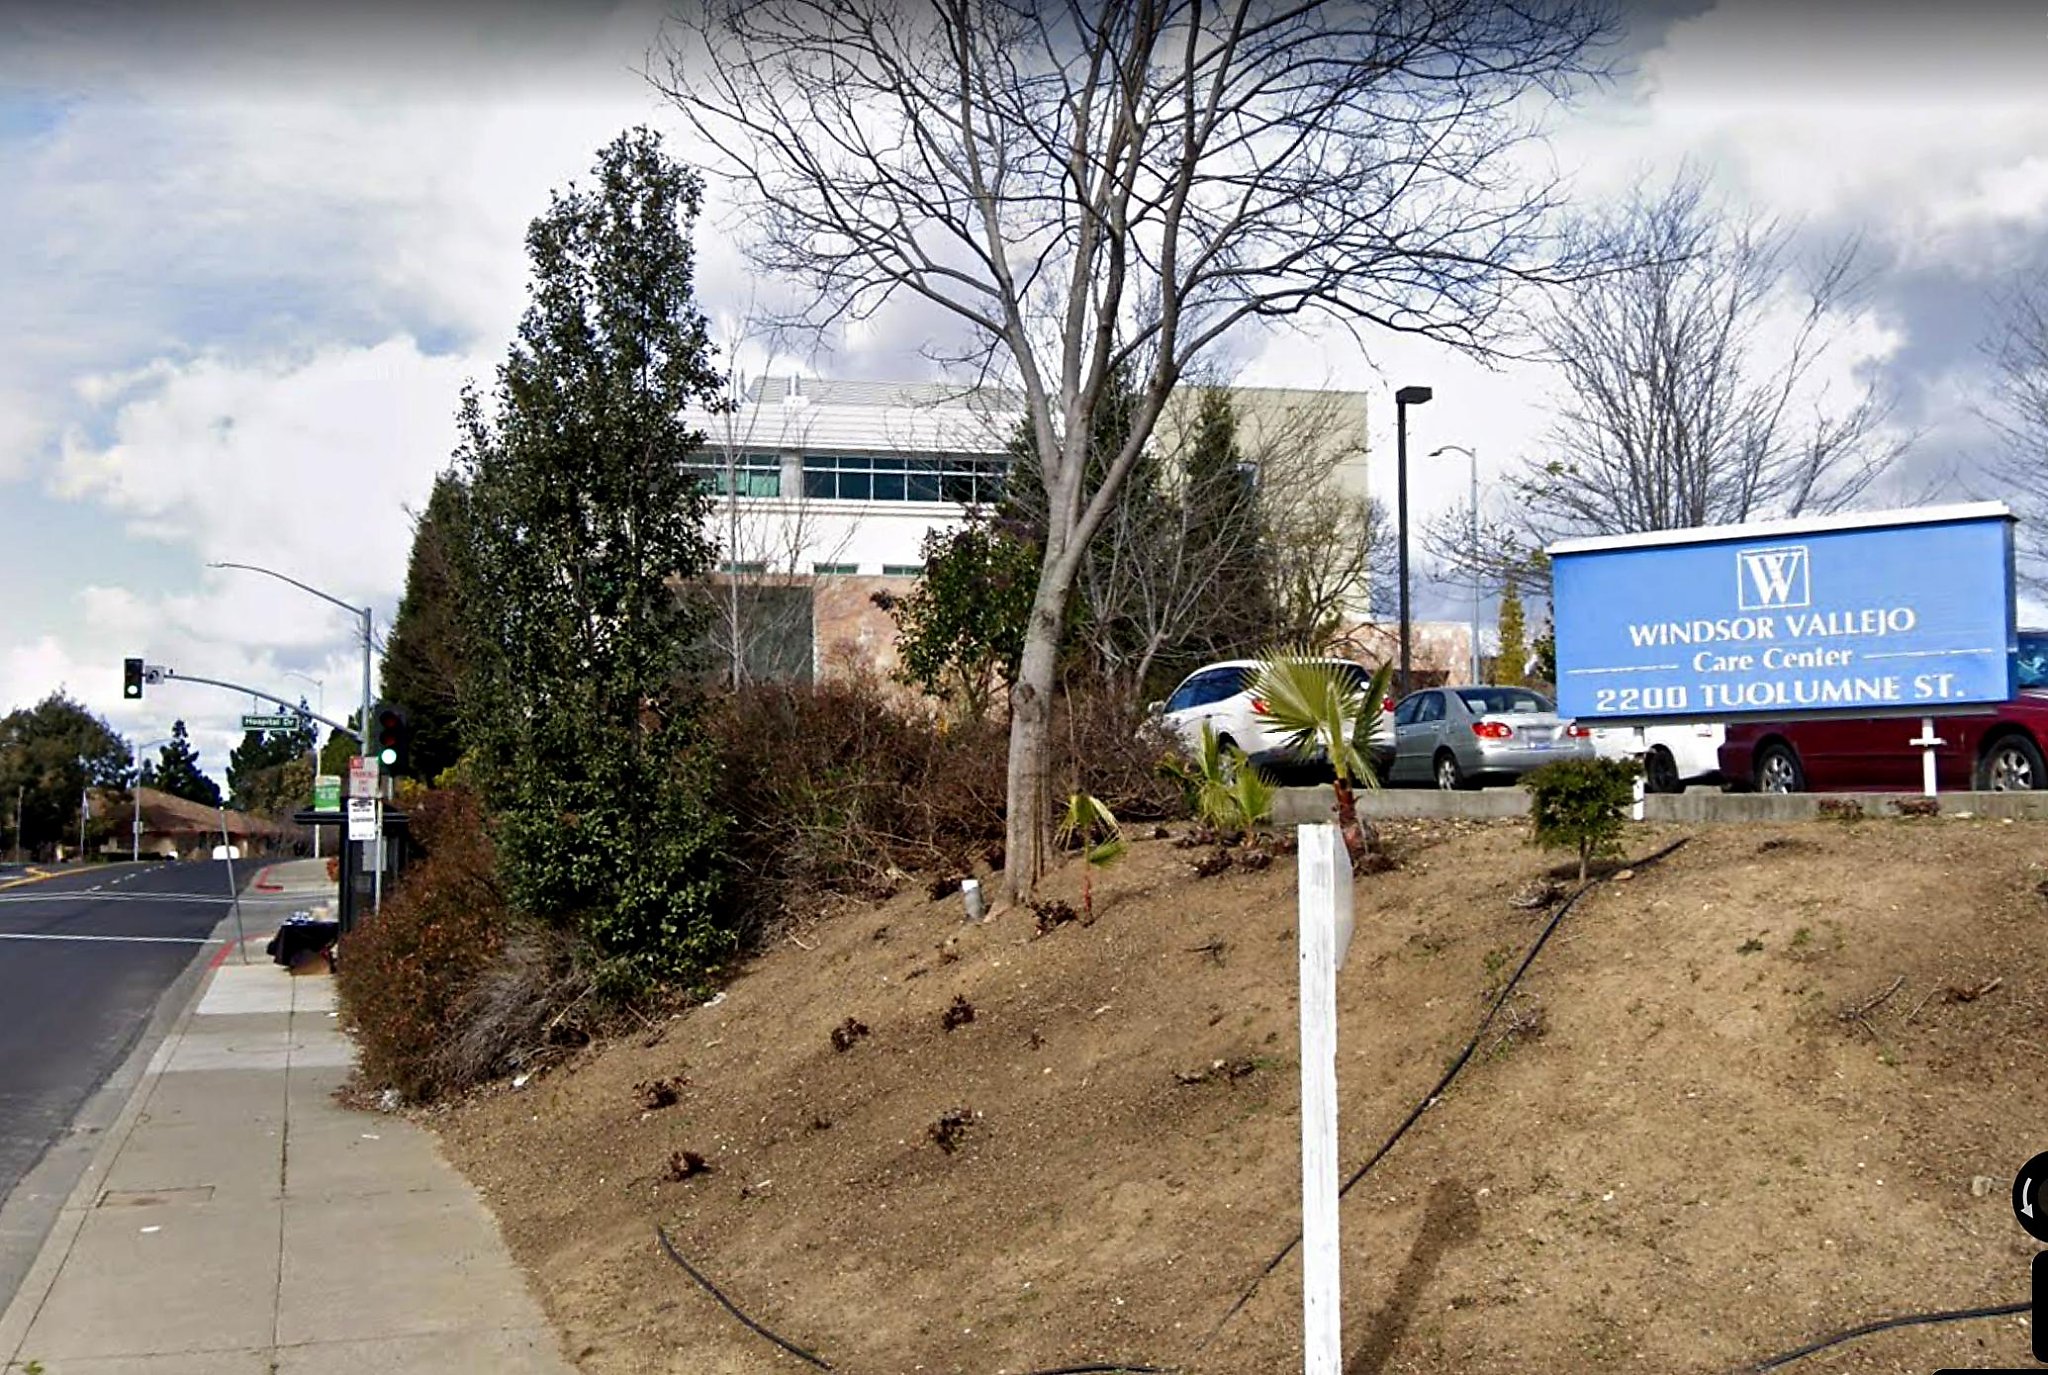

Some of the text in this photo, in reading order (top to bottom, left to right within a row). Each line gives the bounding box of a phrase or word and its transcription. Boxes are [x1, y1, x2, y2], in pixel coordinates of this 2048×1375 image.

[1744, 552, 1799, 606] W
[1629, 607, 1916, 647] WINDSOR VALLEJO
[1693, 647, 1853, 672] Care Center
[1596, 673, 1965, 712] 2200 TUOLUMNE ST.
[245, 718, 294, 726] Hospital Dr
